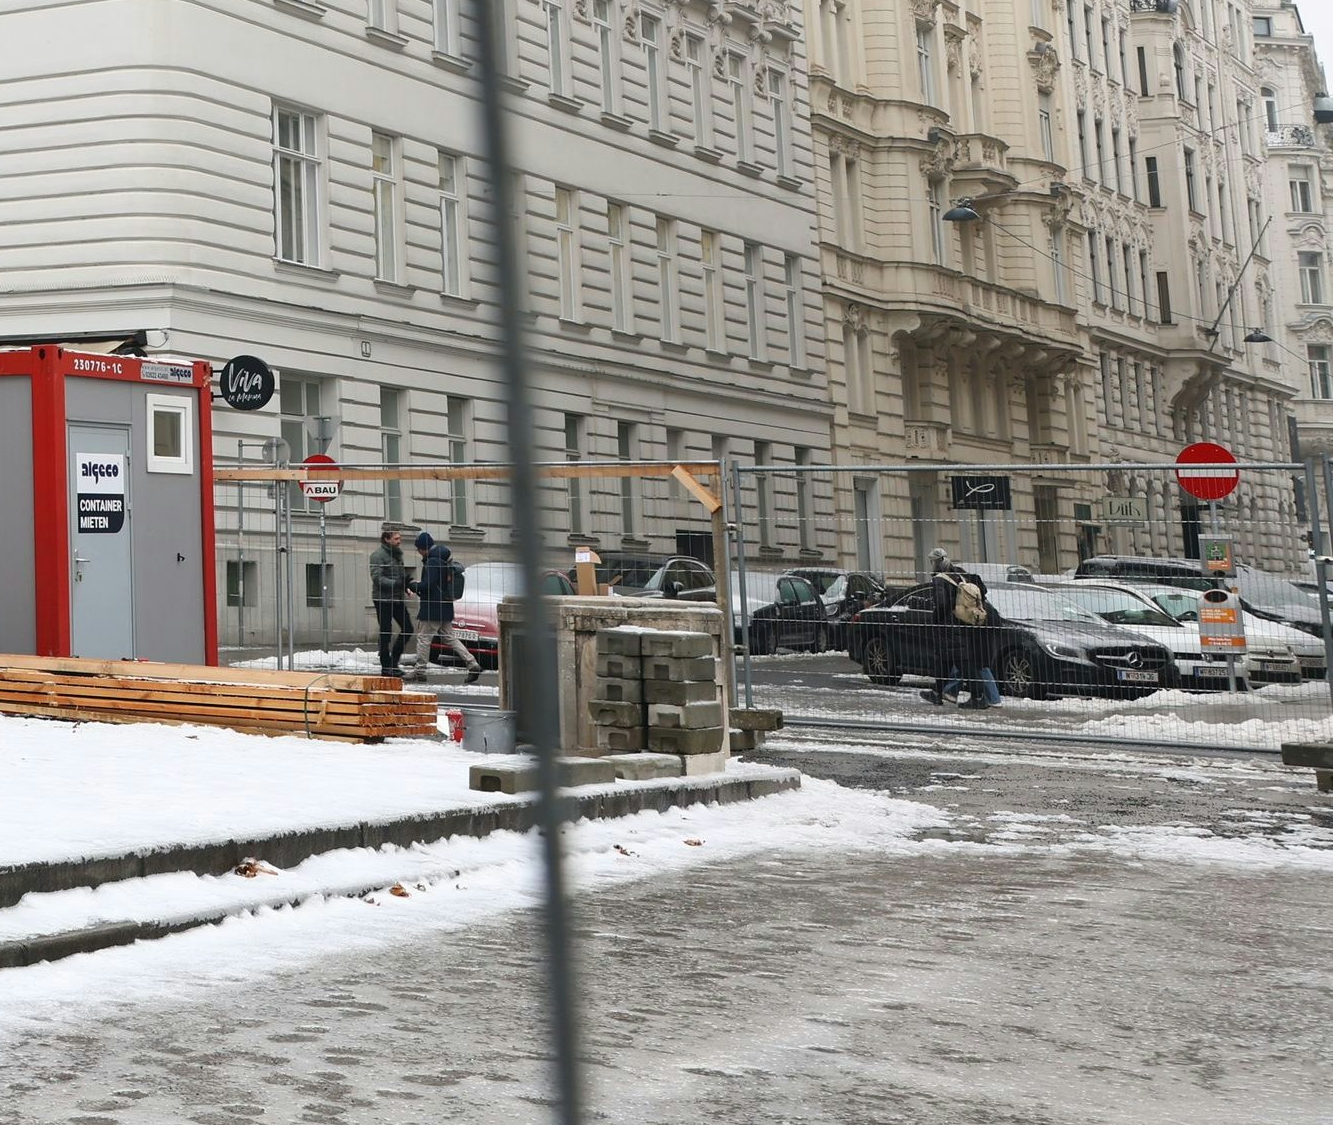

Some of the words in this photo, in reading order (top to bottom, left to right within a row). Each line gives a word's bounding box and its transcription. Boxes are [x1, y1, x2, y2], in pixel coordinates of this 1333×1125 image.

[74, 359, 123, 374] 230776-1C
[81, 461, 119, 484] algeco
[79, 499, 122, 512] CONTAINER
[80, 516, 109, 529] MIETEN
